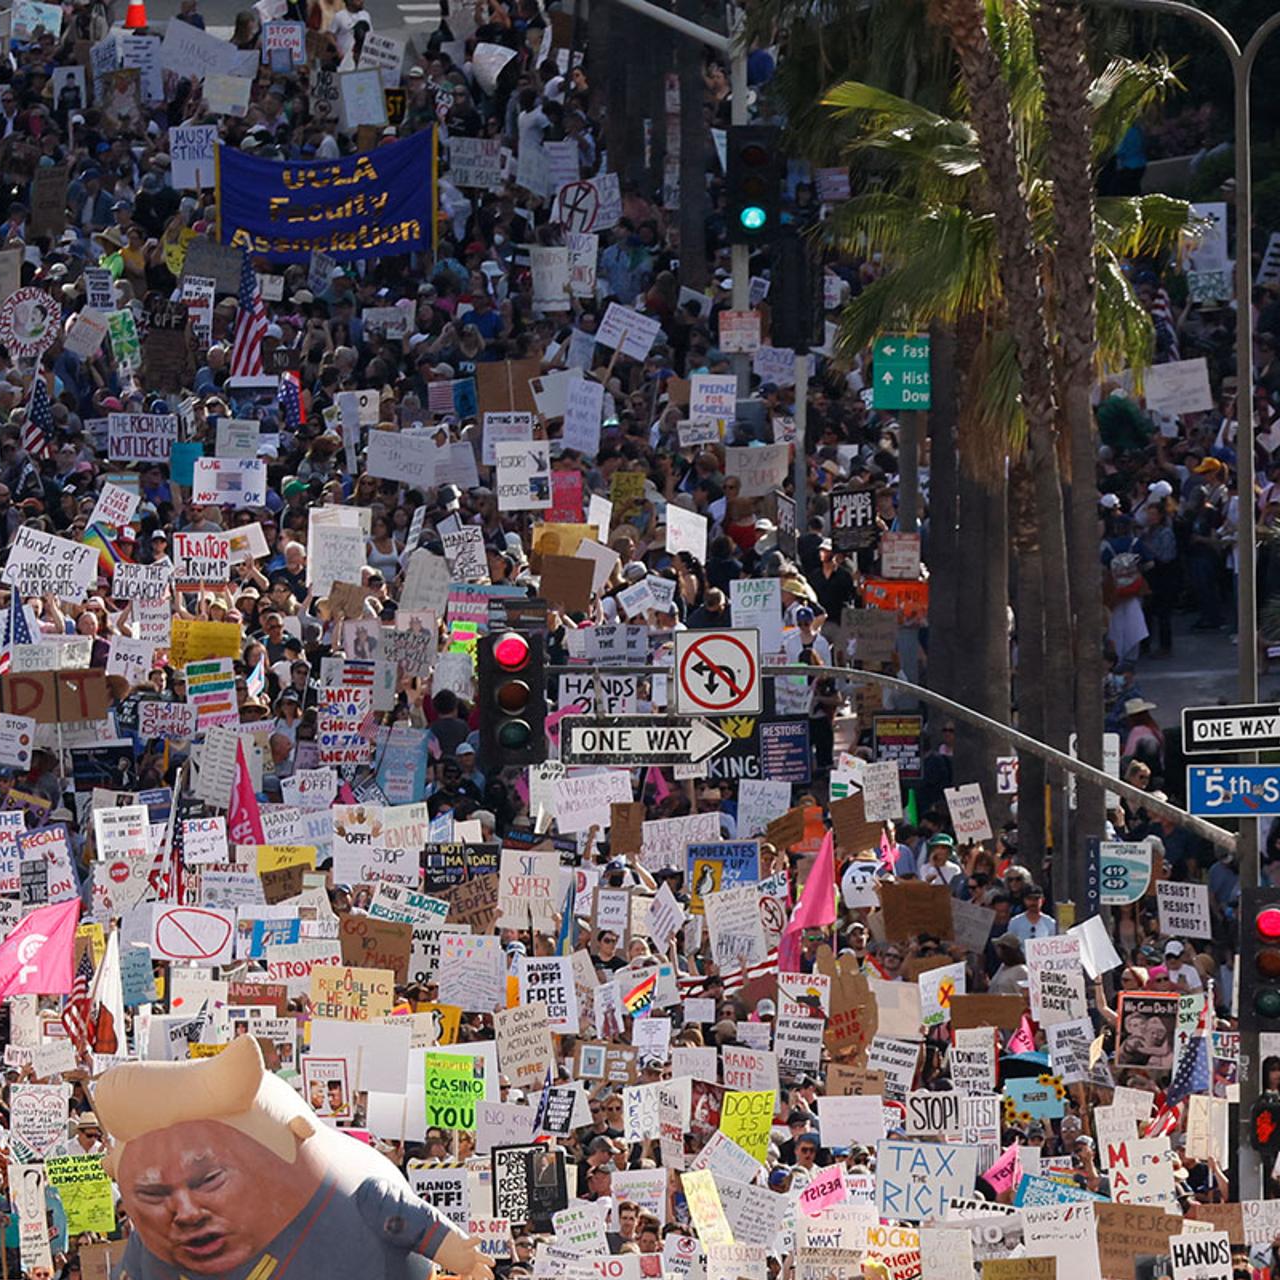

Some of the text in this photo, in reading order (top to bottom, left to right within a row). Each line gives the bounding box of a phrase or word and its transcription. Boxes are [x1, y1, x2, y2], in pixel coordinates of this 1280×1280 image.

[174, 130, 215, 145] MUSK
[282, 157, 379, 190] UCLA
[269, 190, 389, 222] Faculty
[230, 218, 421, 254] Association
[199, 459, 261, 471] WE ARE
[198, 492, 260, 503] NOT OK
[832, 492, 872, 511] HANDS
[833, 505, 873, 528] OFF!
[178, 533, 231, 560] TRAITOR
[184, 559, 229, 578] TRUMP
[735, 580, 776, 594] HANDS
[741, 592, 772, 608] OFF
[1196, 719, 1276, 738] ONE WAY
[582, 729, 691, 752] ONE WAY
[1205, 773, 1252, 807] 5th
[1104, 866, 1125, 876] 419
[1105, 879, 1125, 889] 439
[527, 961, 560, 973] HANDS
[526, 972, 561, 985] OFF!
[781, 973, 828, 988] IMPEACH
[526, 987, 567, 1005] FREE
[430, 1078, 483, 1094] CASINO
[430, 1105, 476, 1128] YOU
[910, 1096, 960, 1131] STOP!
[892, 1145, 956, 1175] TAX
[912, 1174, 928, 1184] THE
[1174, 1239, 1230, 1267] HANDS
